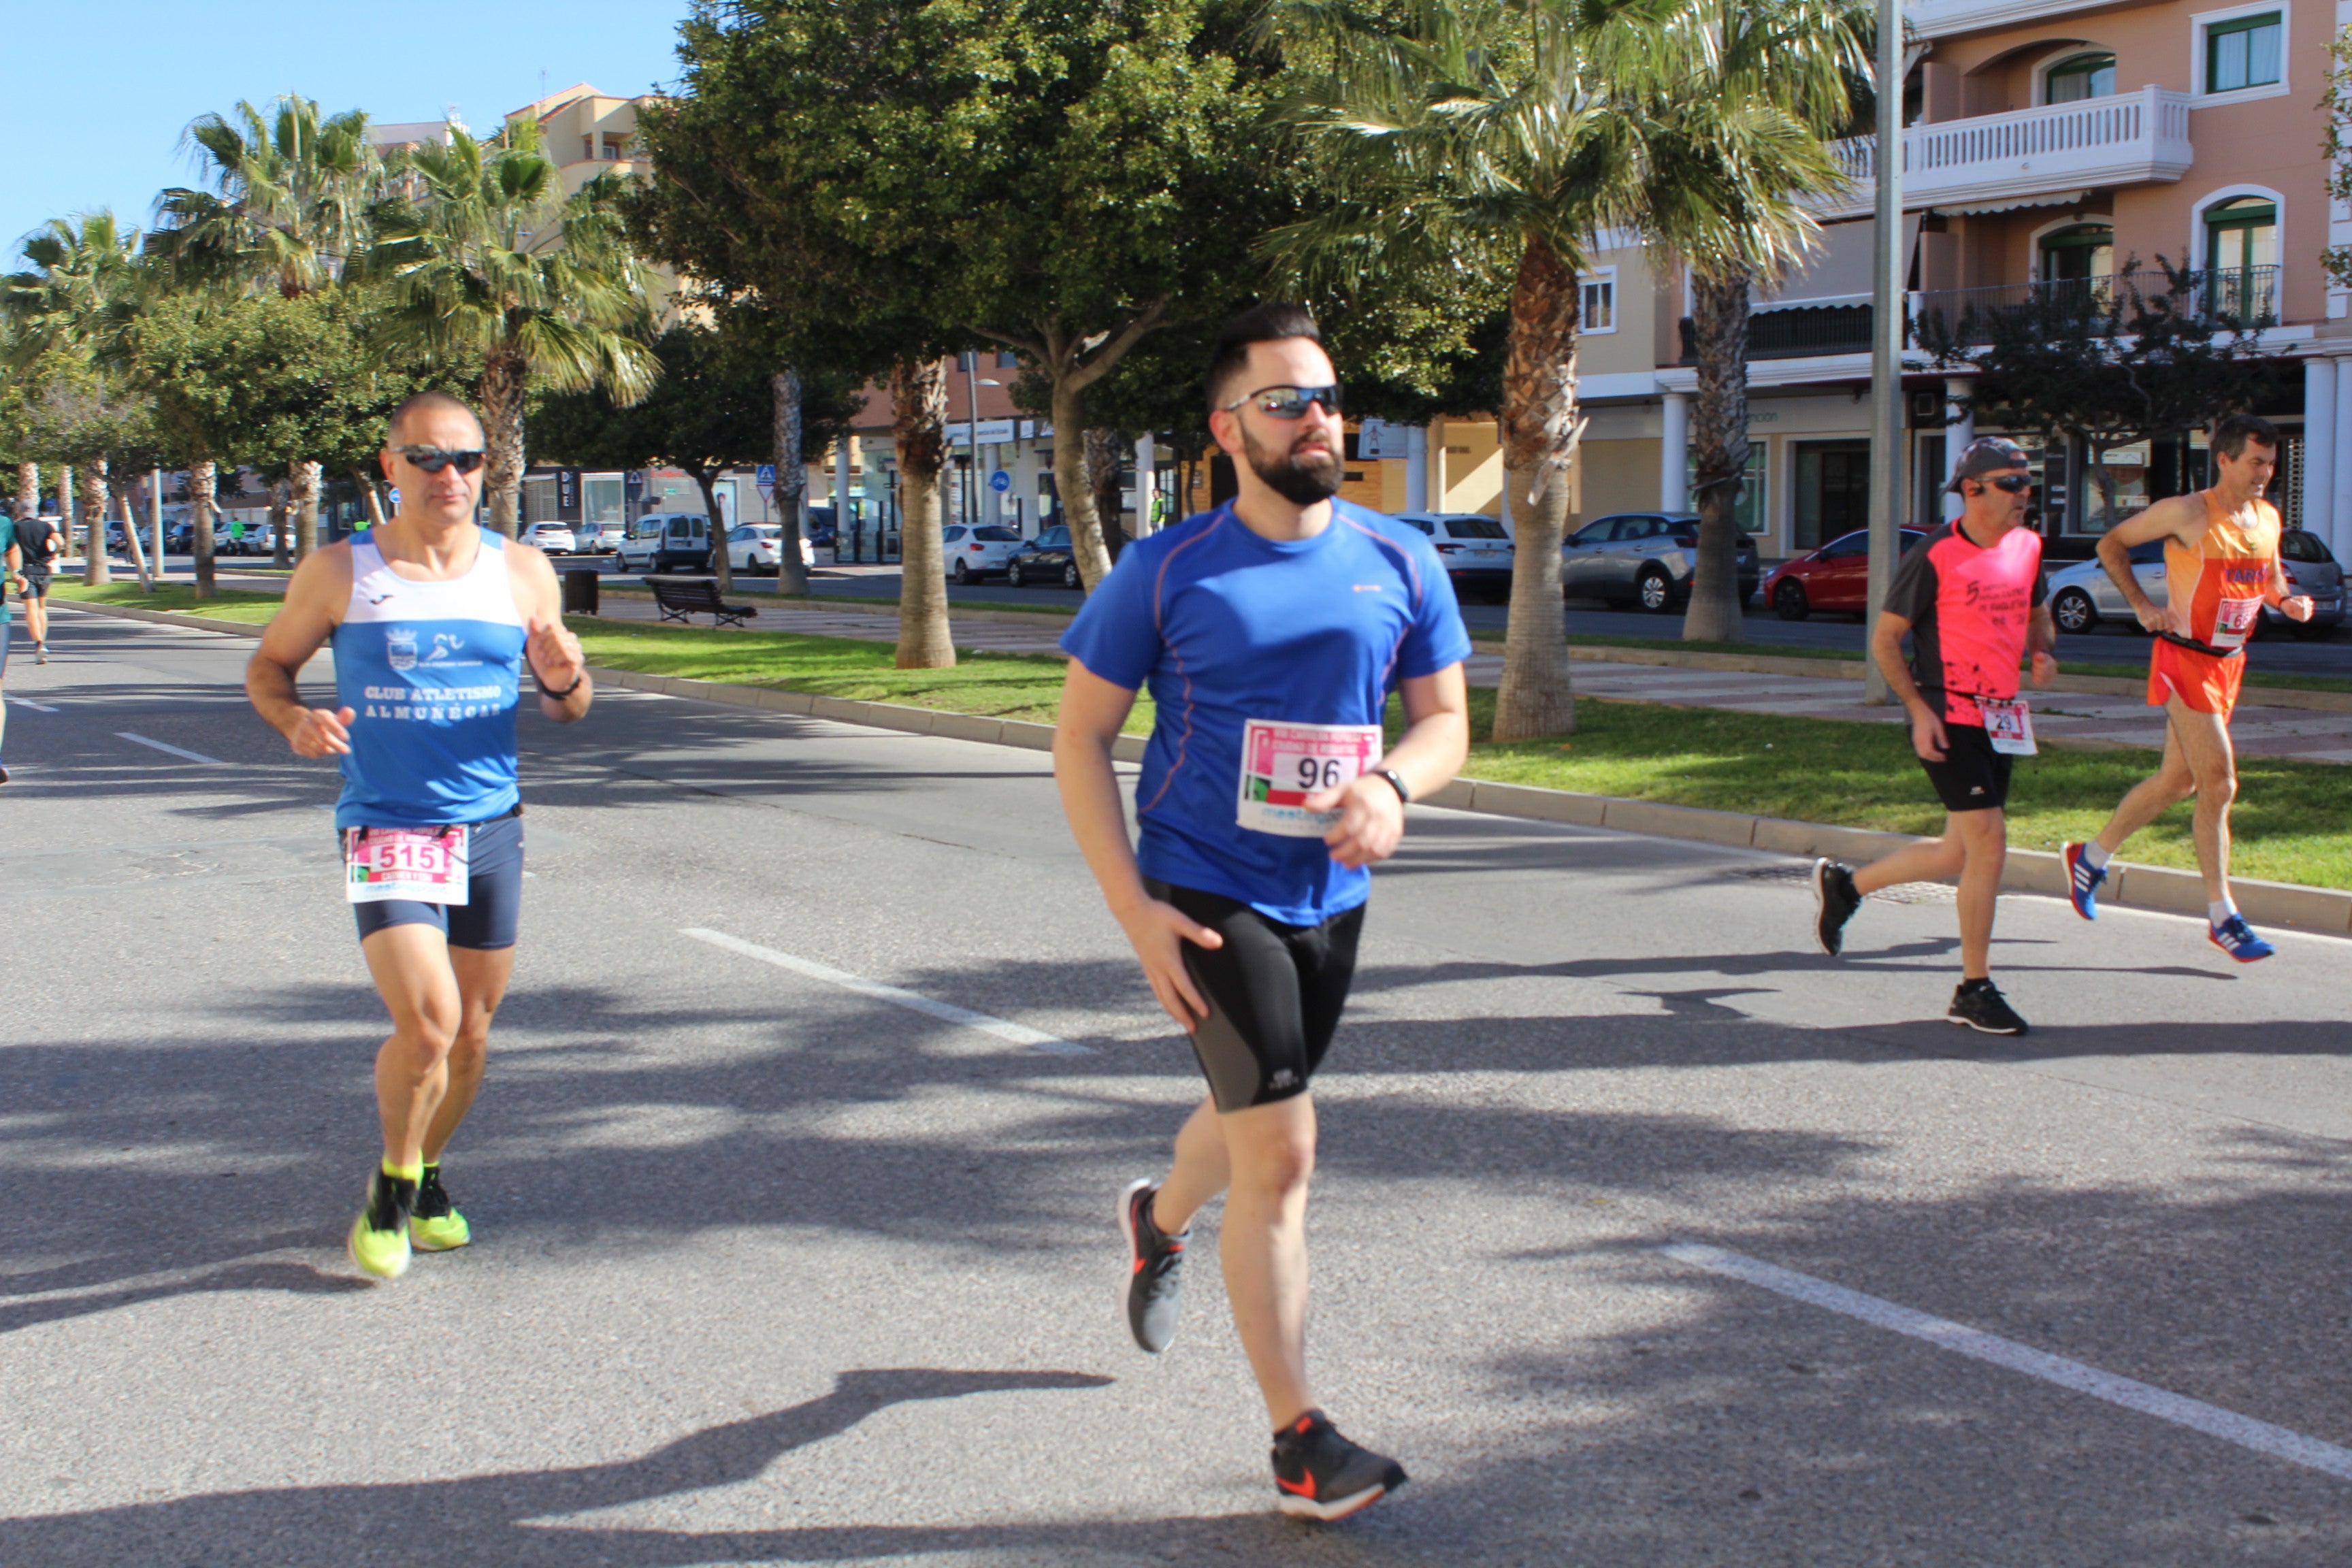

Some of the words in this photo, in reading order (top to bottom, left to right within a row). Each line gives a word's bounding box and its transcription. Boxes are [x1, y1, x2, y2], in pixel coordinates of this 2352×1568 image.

[561, 471, 570, 507] DUE
[364, 685, 406, 700] CLUB
[410, 685, 502, 701] ATLETISMO
[1297, 756, 1341, 789] 96
[379, 845, 436, 870] 515
